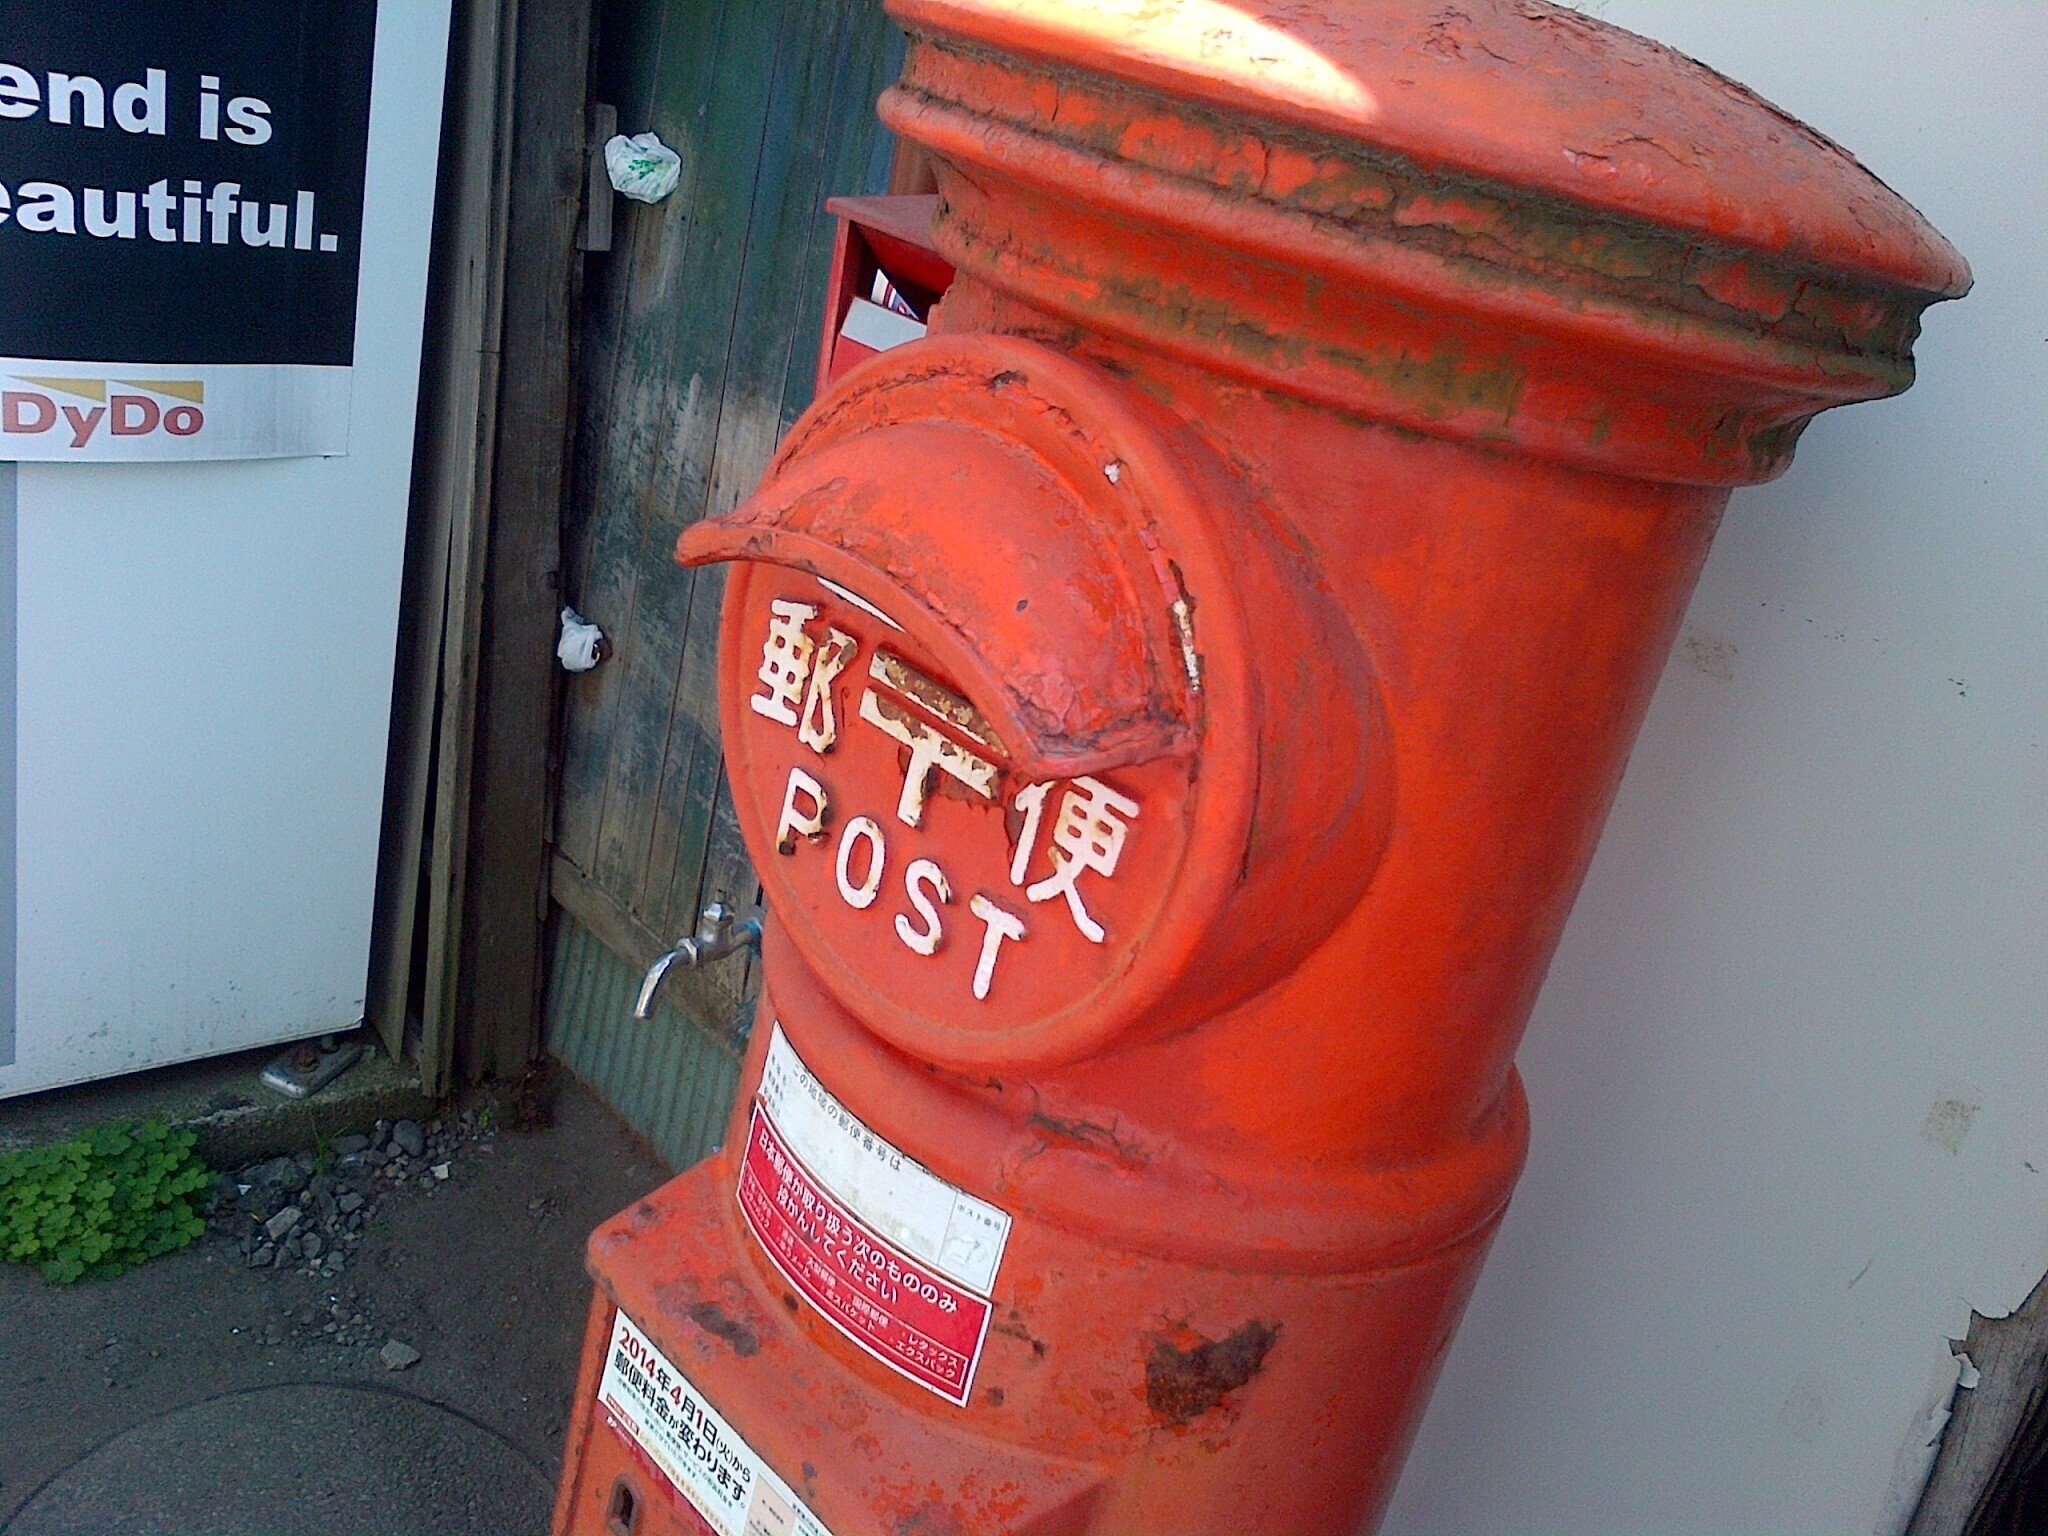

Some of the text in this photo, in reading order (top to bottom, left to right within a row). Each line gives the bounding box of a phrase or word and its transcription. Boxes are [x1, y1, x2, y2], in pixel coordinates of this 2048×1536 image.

[199, 75, 273, 146] is
[0, 179, 338, 252] autiful.
[2, 390, 204, 448] DyDo
[776, 767, 1025, 1001] POST
[758, 1128, 958, 1314] 日本郵便が取り扱う次のもののみ
[776, 1187, 898, 1304] 投かんしてください
[613, 1349, 747, 1509] 郵便料金が変わります。
